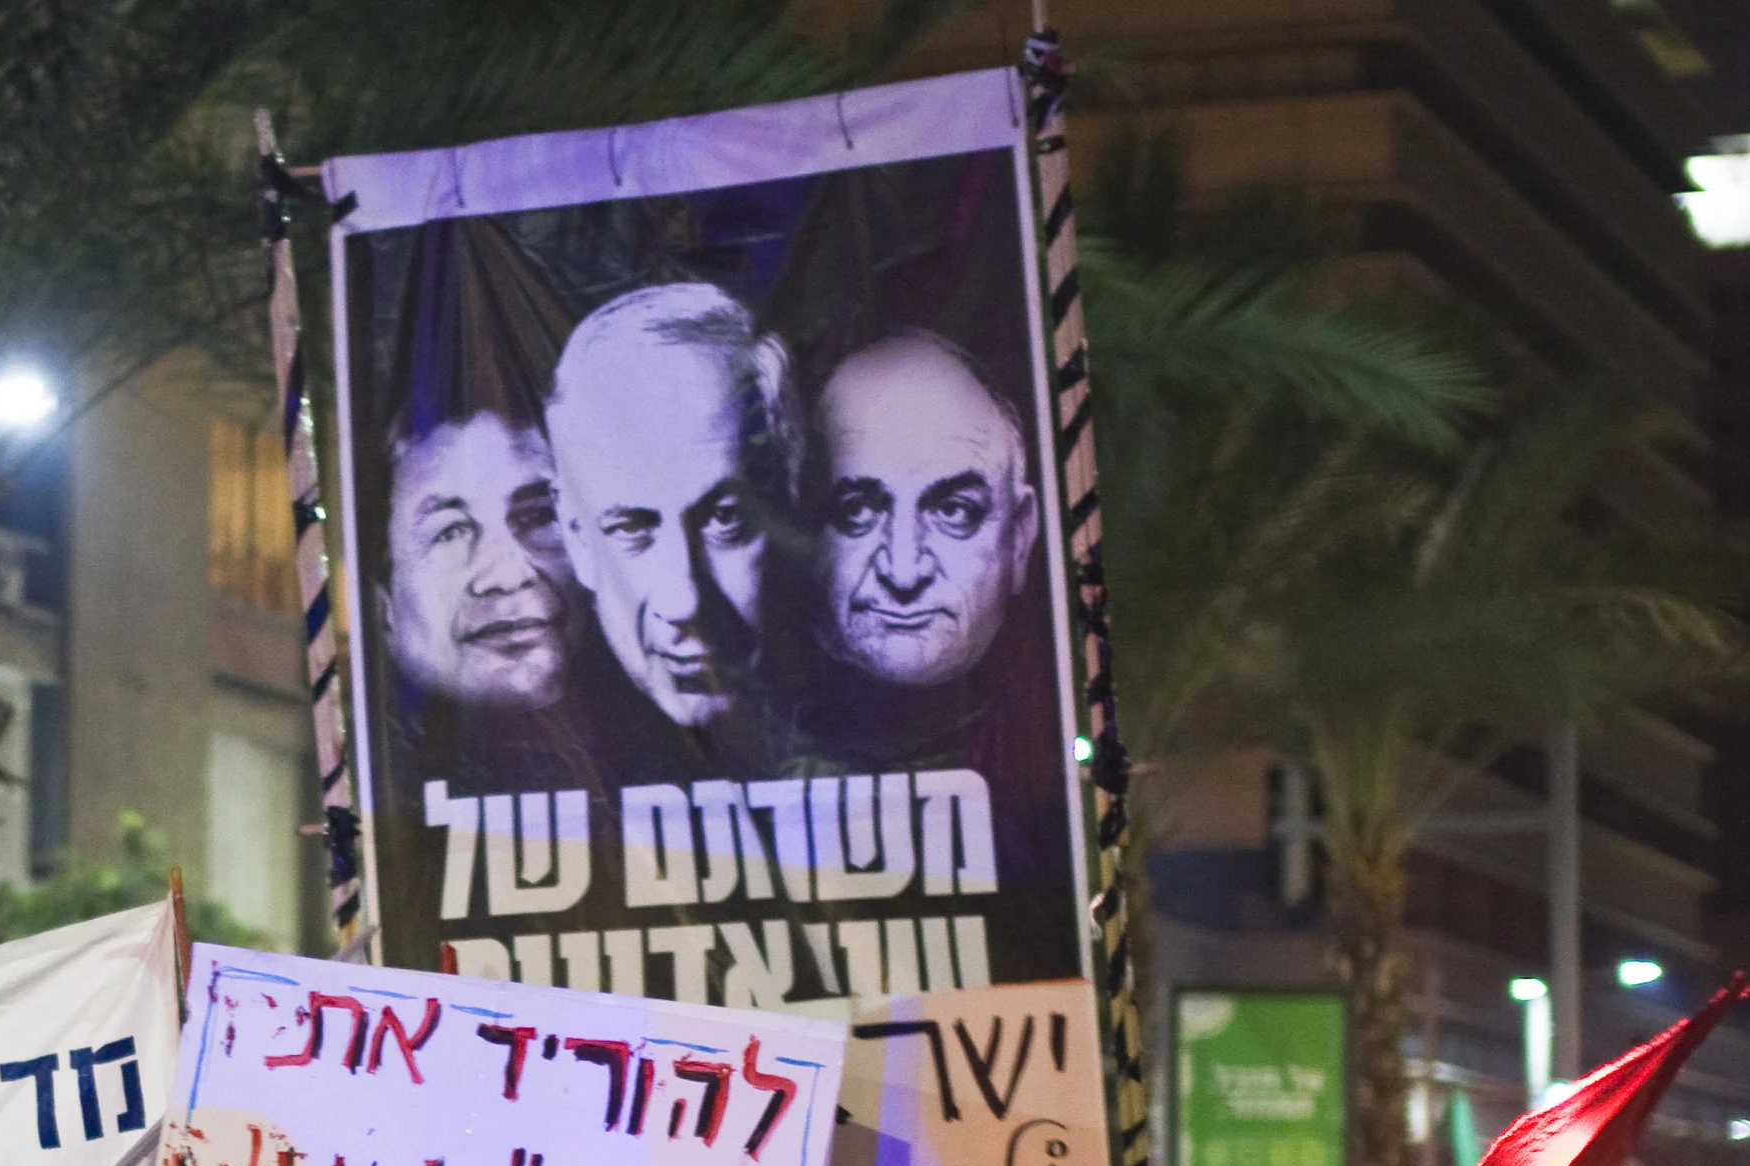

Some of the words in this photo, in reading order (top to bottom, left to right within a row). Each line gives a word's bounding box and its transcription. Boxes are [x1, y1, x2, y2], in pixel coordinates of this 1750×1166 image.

[424, 780, 591, 919] של
[622, 769, 998, 908] משרתם
[477, 1022, 797, 1161] להוריד
